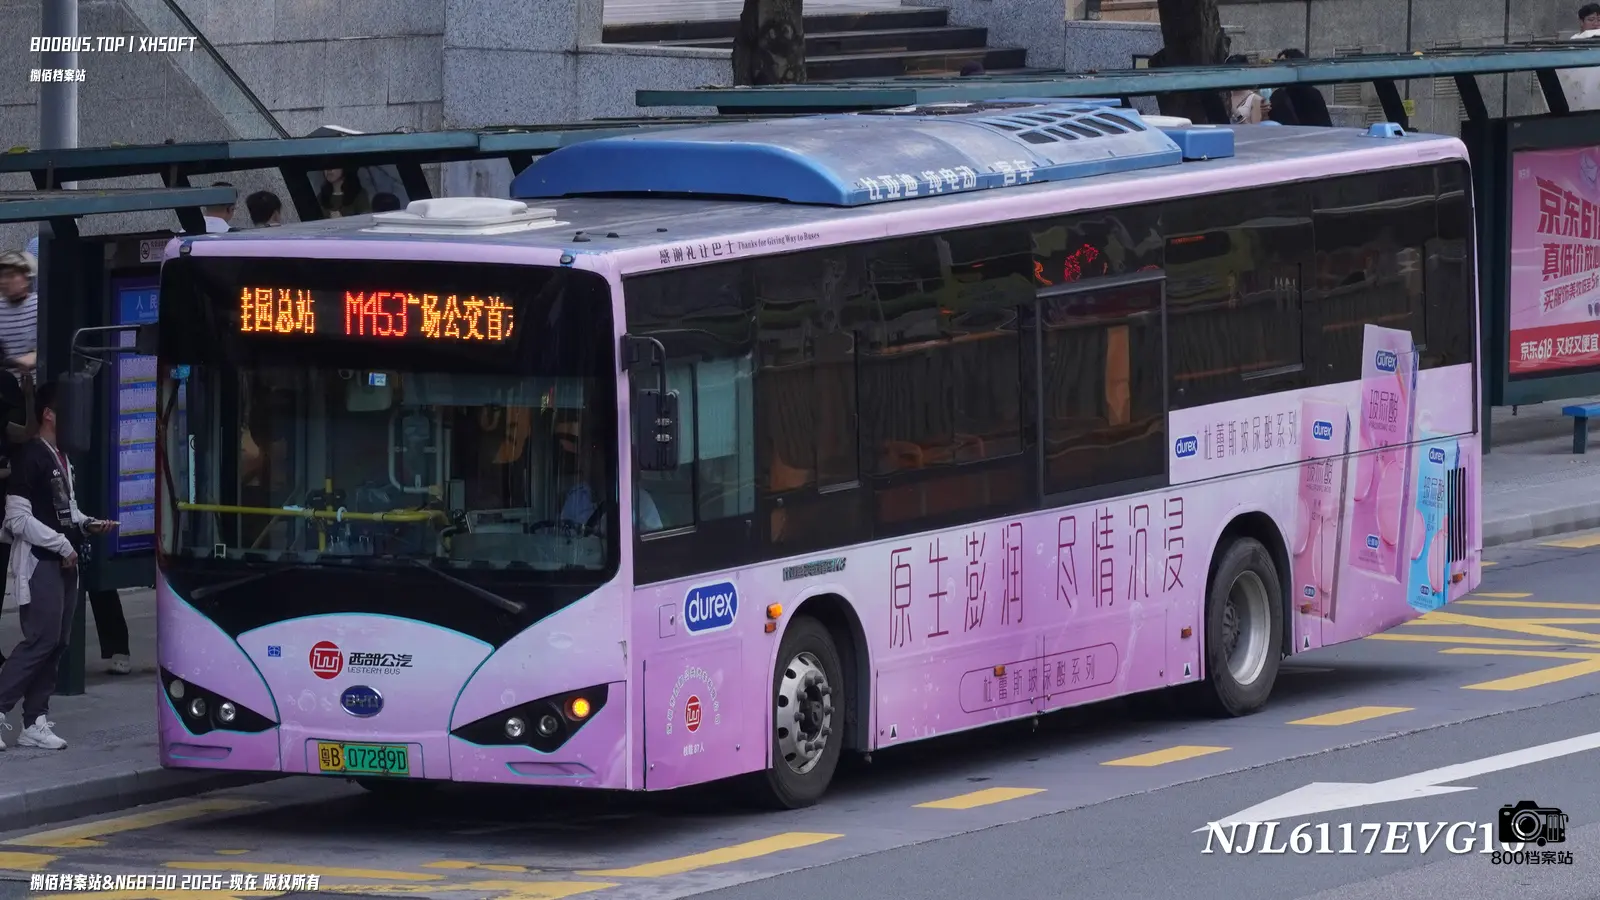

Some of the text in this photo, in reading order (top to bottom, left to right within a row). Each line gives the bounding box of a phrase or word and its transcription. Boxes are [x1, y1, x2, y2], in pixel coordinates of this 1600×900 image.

[860, 159, 1035, 200] 比亚迪 纯电动 客车
[1535, 175, 1600, 240] 京东61
[659, 231, 820, 264] 感谢礼让巴士 Thanks for Giving Way to Buses
[345, 291, 408, 337] M453
[407, 292, 514, 341] 场公交首
[1520, 333, 1599, 361] 京东618 又好又便宜
[1369, 389, 1399, 423] 玻尿酸
[1176, 437, 1198, 455] durex
[1203, 409, 1298, 461] 杜蕾斯玻尿酸系列
[1314, 423, 1333, 438] durex
[889, 497, 1185, 650] 原生澎润 尽情沉浸
[688, 591, 735, 623] durex
[348, 652, 414, 668] 西部公汽
[384, 667, 401, 675] BUS
[983, 653, 1096, 703] 杜蕾斯玻尿酸系列
[345, 694, 379, 708] BYD
[321, 747, 407, 770] 粤B 07289D
